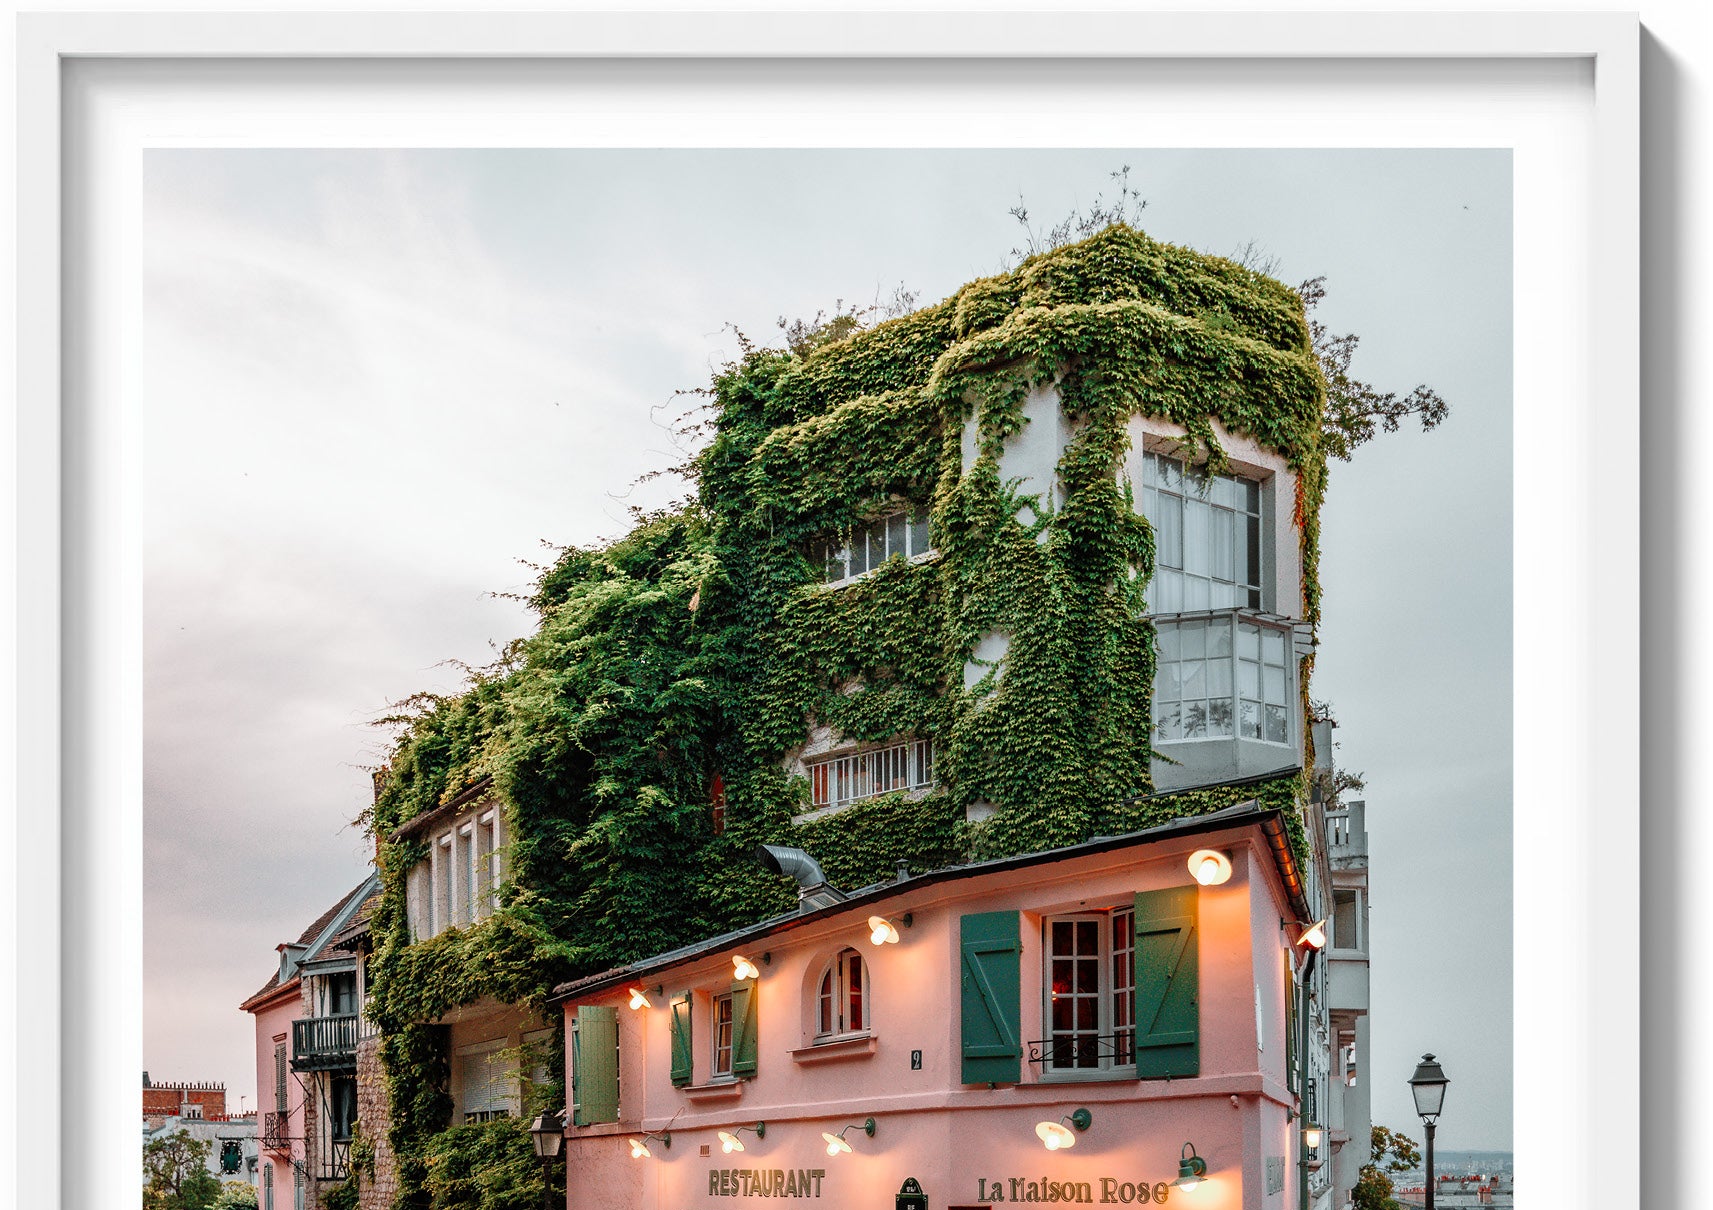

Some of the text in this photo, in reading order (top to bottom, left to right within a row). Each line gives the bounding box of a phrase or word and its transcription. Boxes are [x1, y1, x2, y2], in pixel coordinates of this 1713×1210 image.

[913, 1051, 920, 1069] 2
[708, 1168, 825, 1198] RESTAURANT
[977, 1176, 1170, 1205] La Maison Rose
